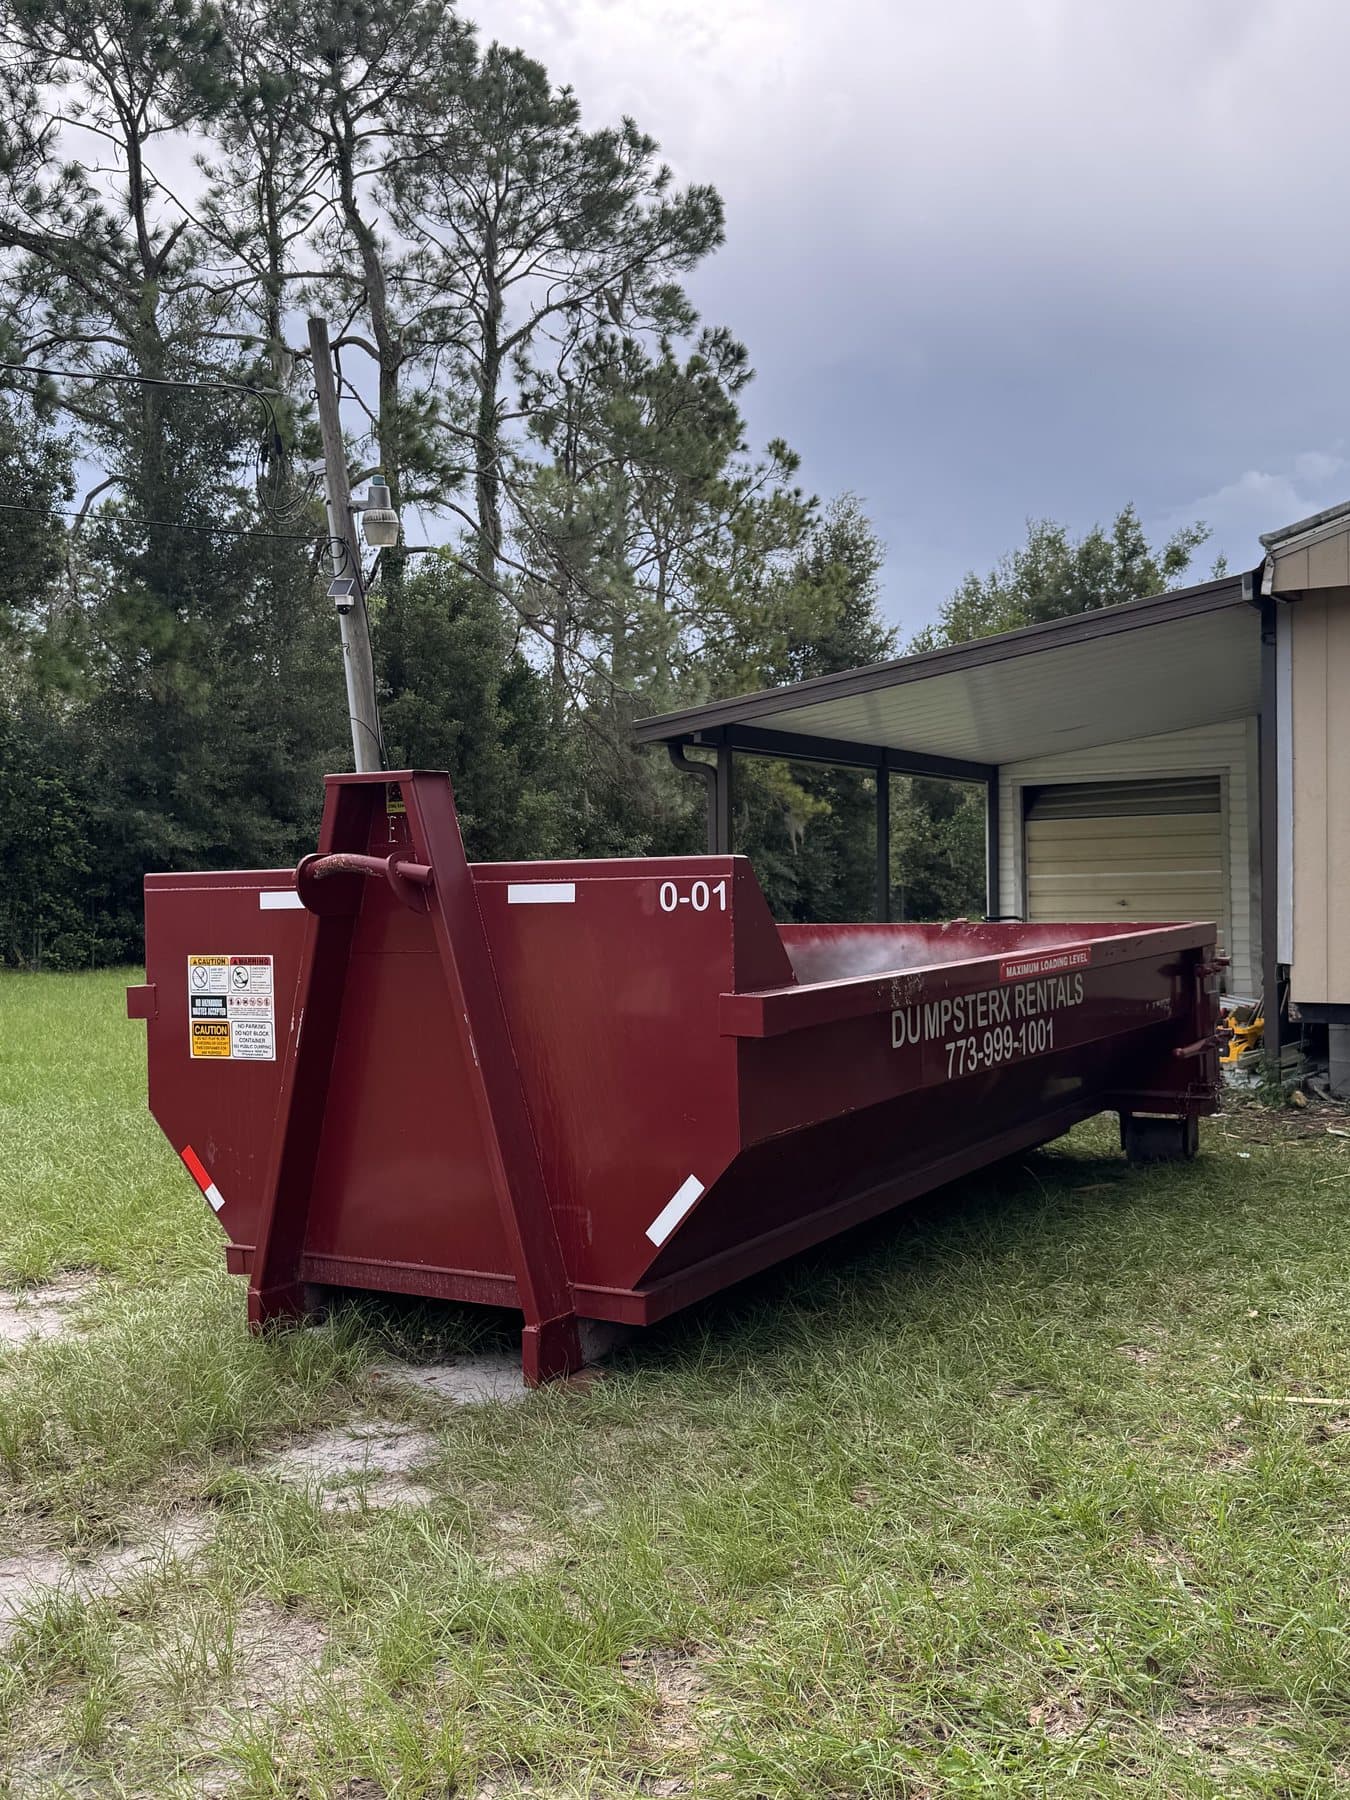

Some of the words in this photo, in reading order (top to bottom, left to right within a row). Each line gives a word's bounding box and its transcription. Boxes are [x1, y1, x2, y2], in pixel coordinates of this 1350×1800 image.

[660, 880, 726, 912] 0-01
[1006, 960, 1040, 978] MAXIMUM
[1040, 956, 1069, 972] LOADING
[1070, 952, 1088, 966] LEVEL
[891, 987, 1011, 1049] DUMPSTERX
[1015, 973, 1084, 1019] RENTALS
[194, 1025, 228, 1035] CAUTION
[945, 1017, 1054, 1080] 773-999-1001
